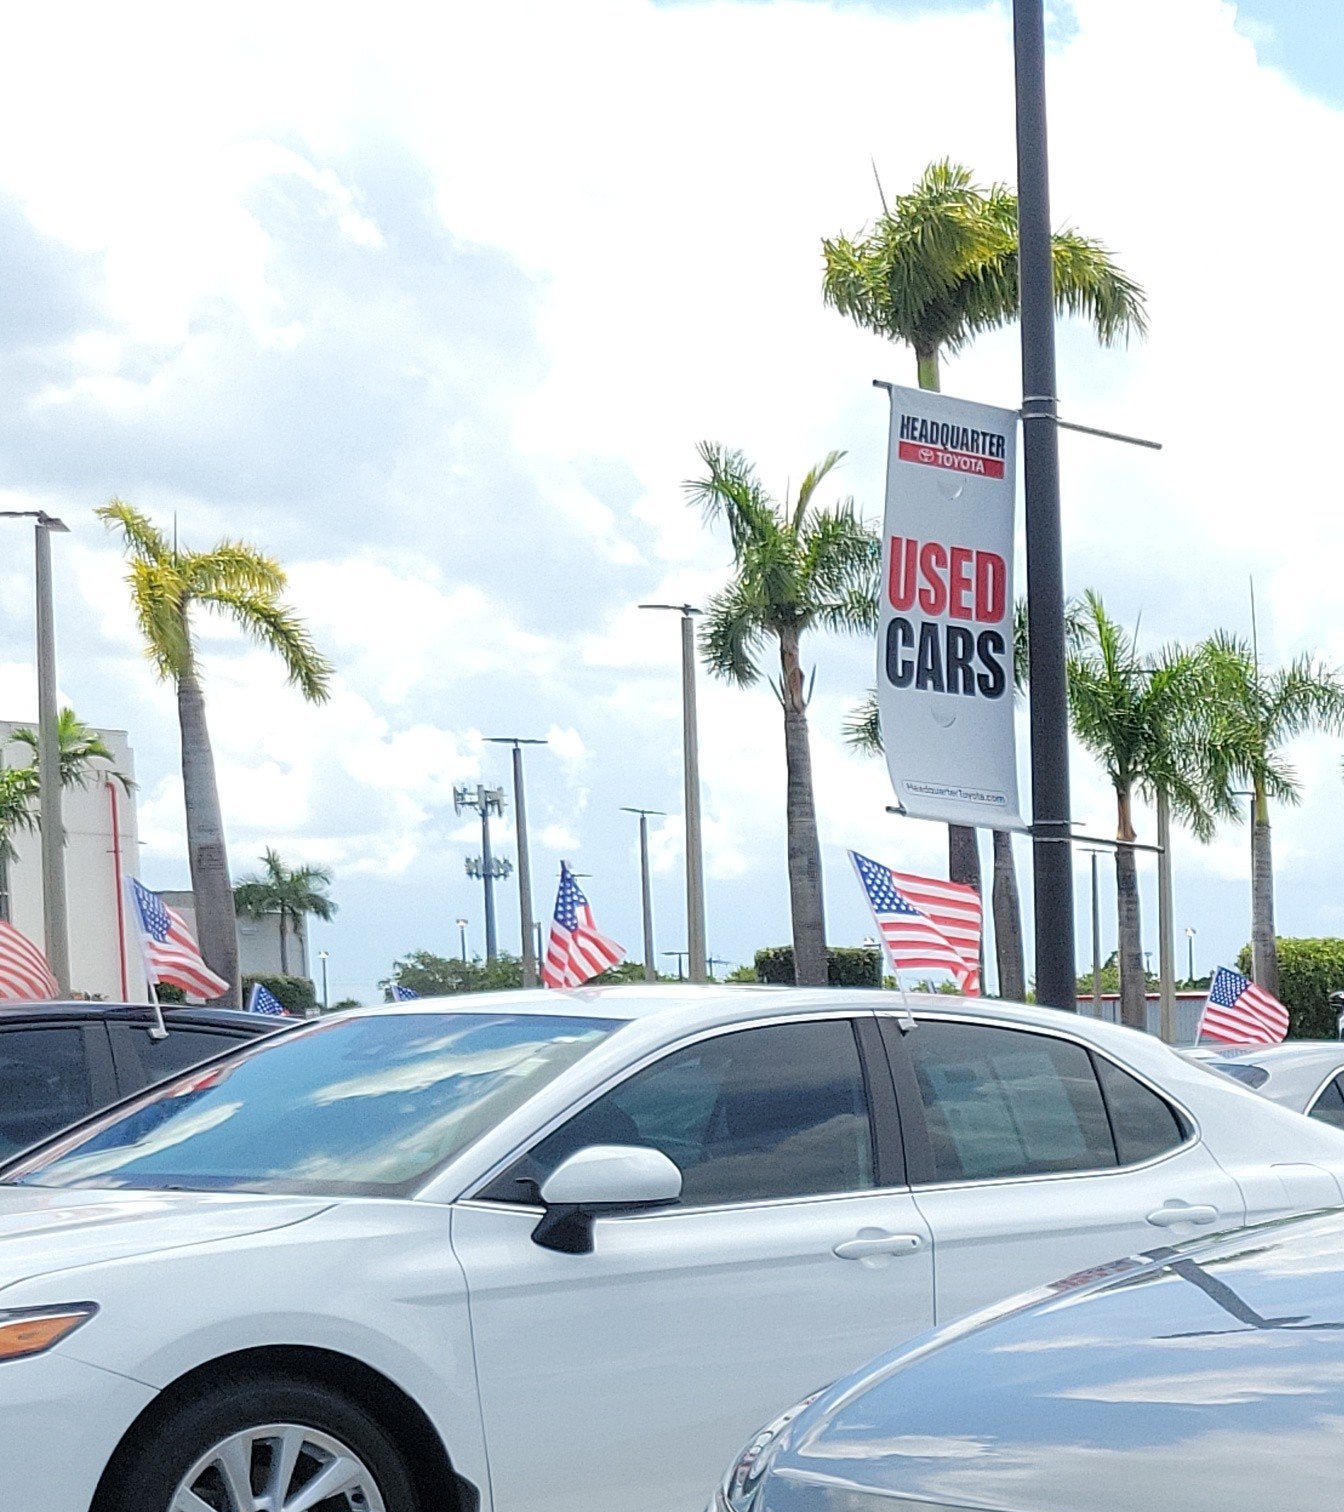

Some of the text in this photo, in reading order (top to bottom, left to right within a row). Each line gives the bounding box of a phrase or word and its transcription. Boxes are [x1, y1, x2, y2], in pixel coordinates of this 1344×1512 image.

[899, 413, 1006, 460] HEADQUARTER
[936, 451, 985, 474] TOYOTA
[887, 535, 1005, 624] USED
[885, 616, 1006, 700] CARS
